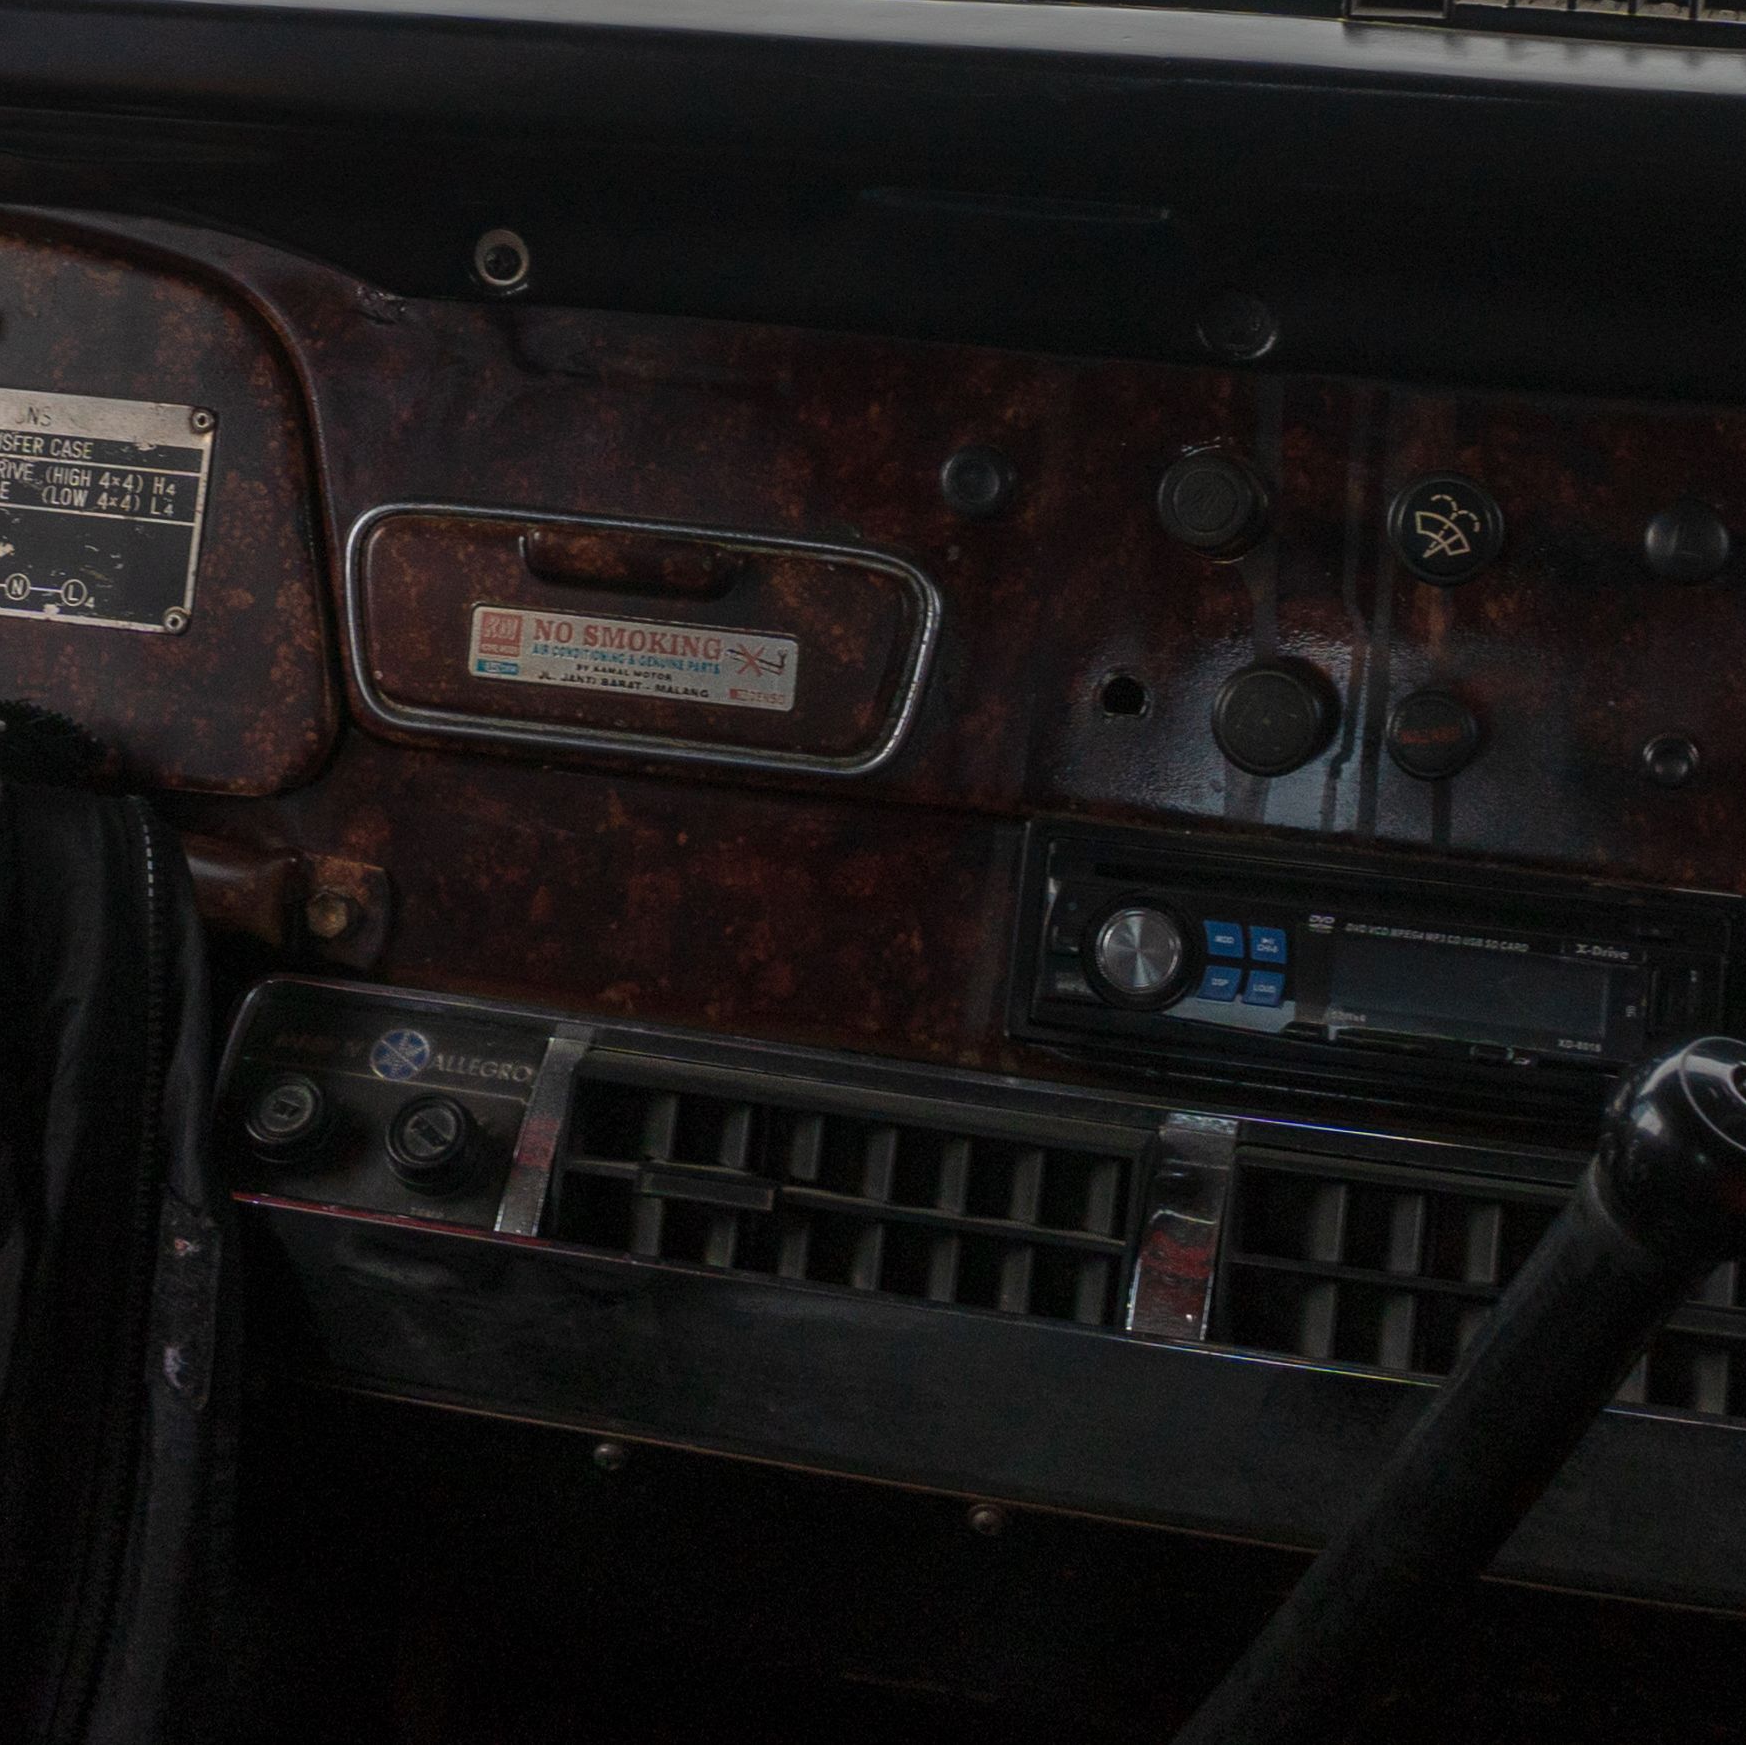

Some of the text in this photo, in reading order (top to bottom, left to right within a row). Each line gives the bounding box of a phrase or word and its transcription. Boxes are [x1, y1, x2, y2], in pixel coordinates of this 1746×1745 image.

[50, 438, 94, 460] CASE
[45, 467, 92, 489] (HIGH
[42, 484, 87, 507] (LOW
[533, 618, 573, 644] NO
[583, 624, 722, 661] SMOKING
[633, 669, 672, 681] MOTOR
[688, 660, 720, 675] PARTS
[600, 678, 642, 690] BARAT
[654, 684, 710, 698] MALANG
[1500, 941, 1530, 953] CARD
[1575, 943, 1631, 960] X-Drive
[432, 1052, 534, 1083] ALLEGRO
